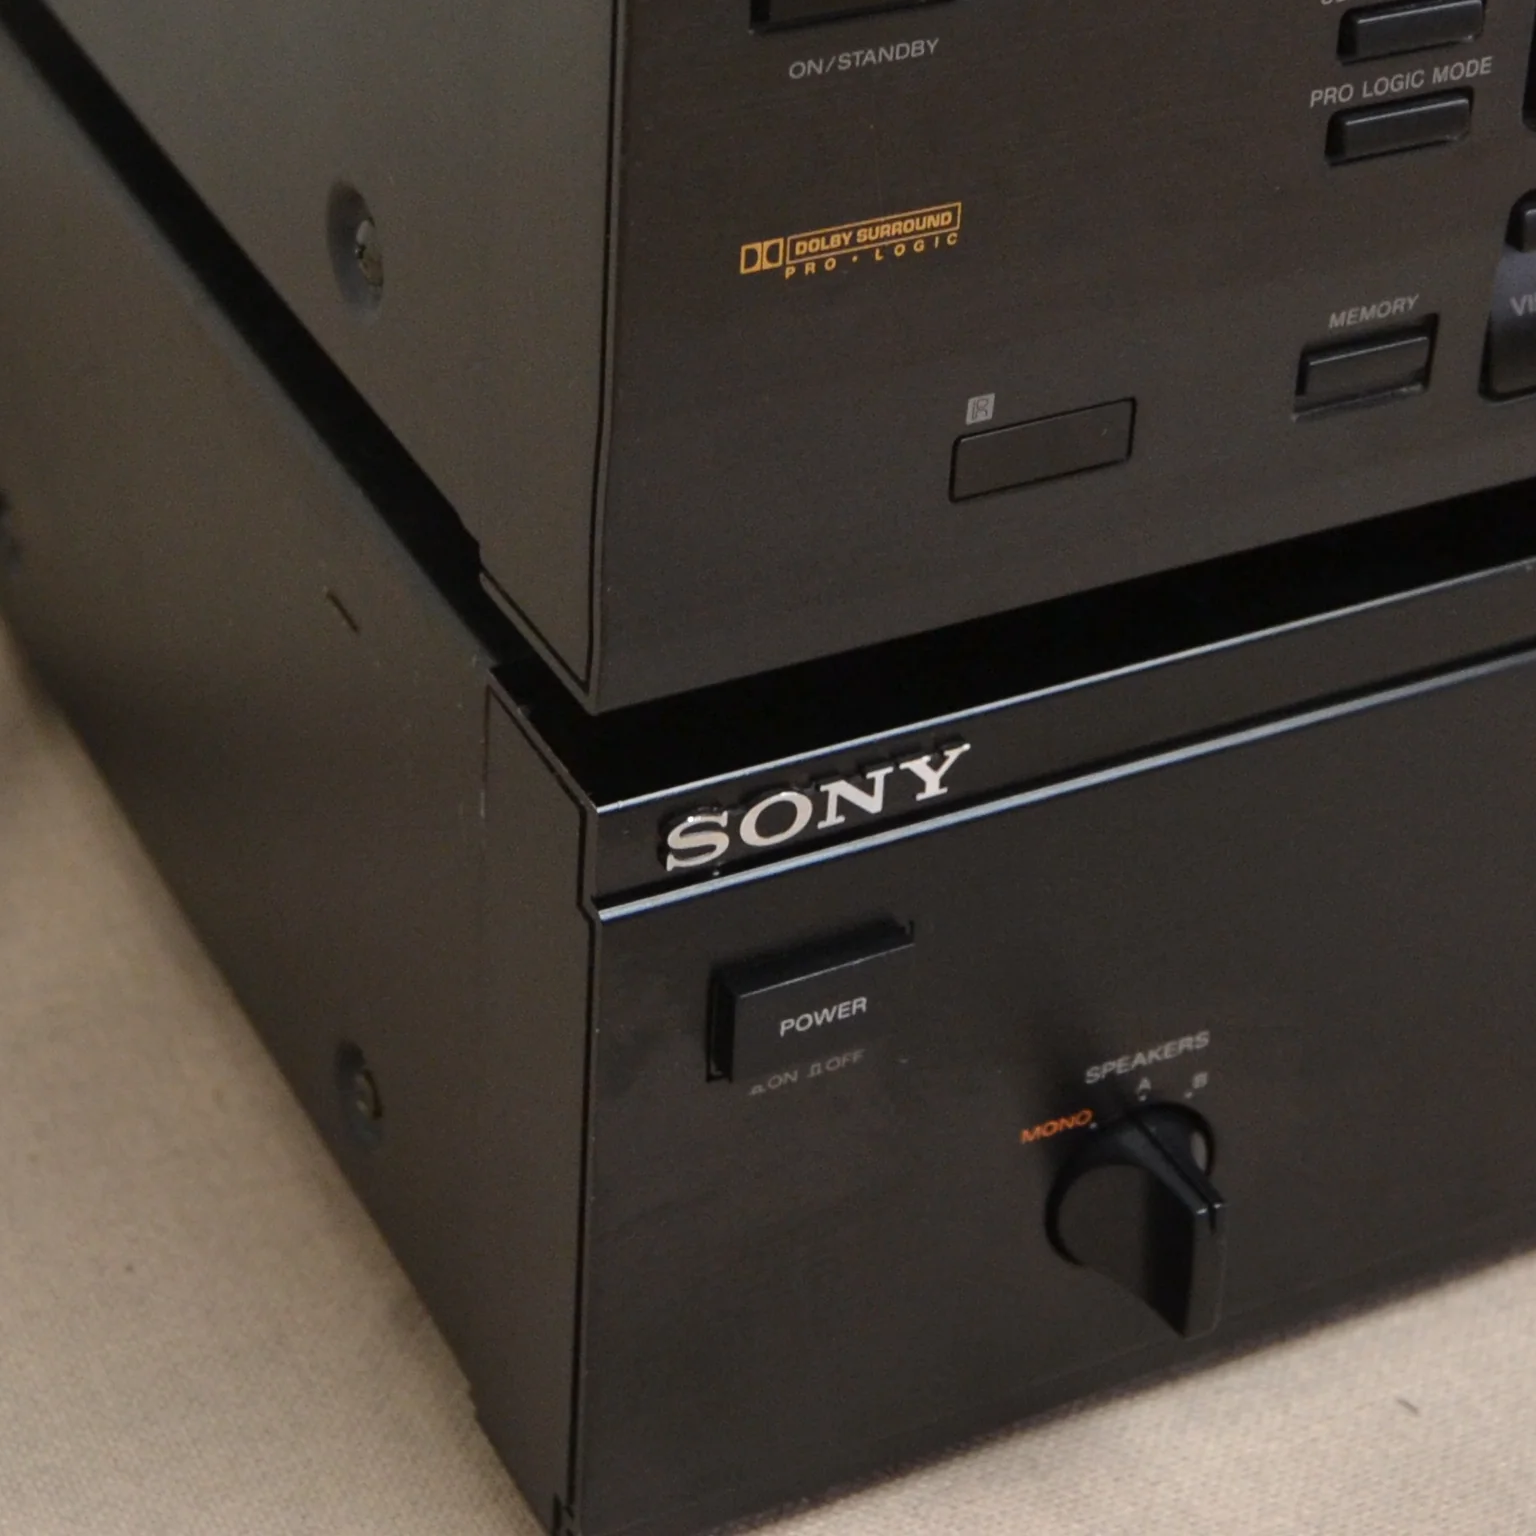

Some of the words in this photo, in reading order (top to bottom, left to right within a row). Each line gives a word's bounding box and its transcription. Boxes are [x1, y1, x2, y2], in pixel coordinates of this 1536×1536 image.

[787, 37, 940, 80] ON/STANDBY
[1309, 83, 1354, 109] PRO
[1362, 70, 1426, 99] LOGIC
[1431, 56, 1494, 84] MODE
[795, 232, 852, 257] DOLBY
[856, 211, 953, 243] SURROUND
[784, 257, 836, 280] PRO
[875, 232, 960, 262] LOGIC
[1328, 294, 1420, 330] MEMORY
[666, 743, 972, 872] SONY
[779, 996, 868, 1038] POWER
[767, 1069, 799, 1091] ON
[824, 1048, 867, 1073] OFF
[1084, 1030, 1211, 1085] SPEAKERS
[1135, 1076, 1152, 1095] A
[1019, 1108, 1094, 1144] MONO
